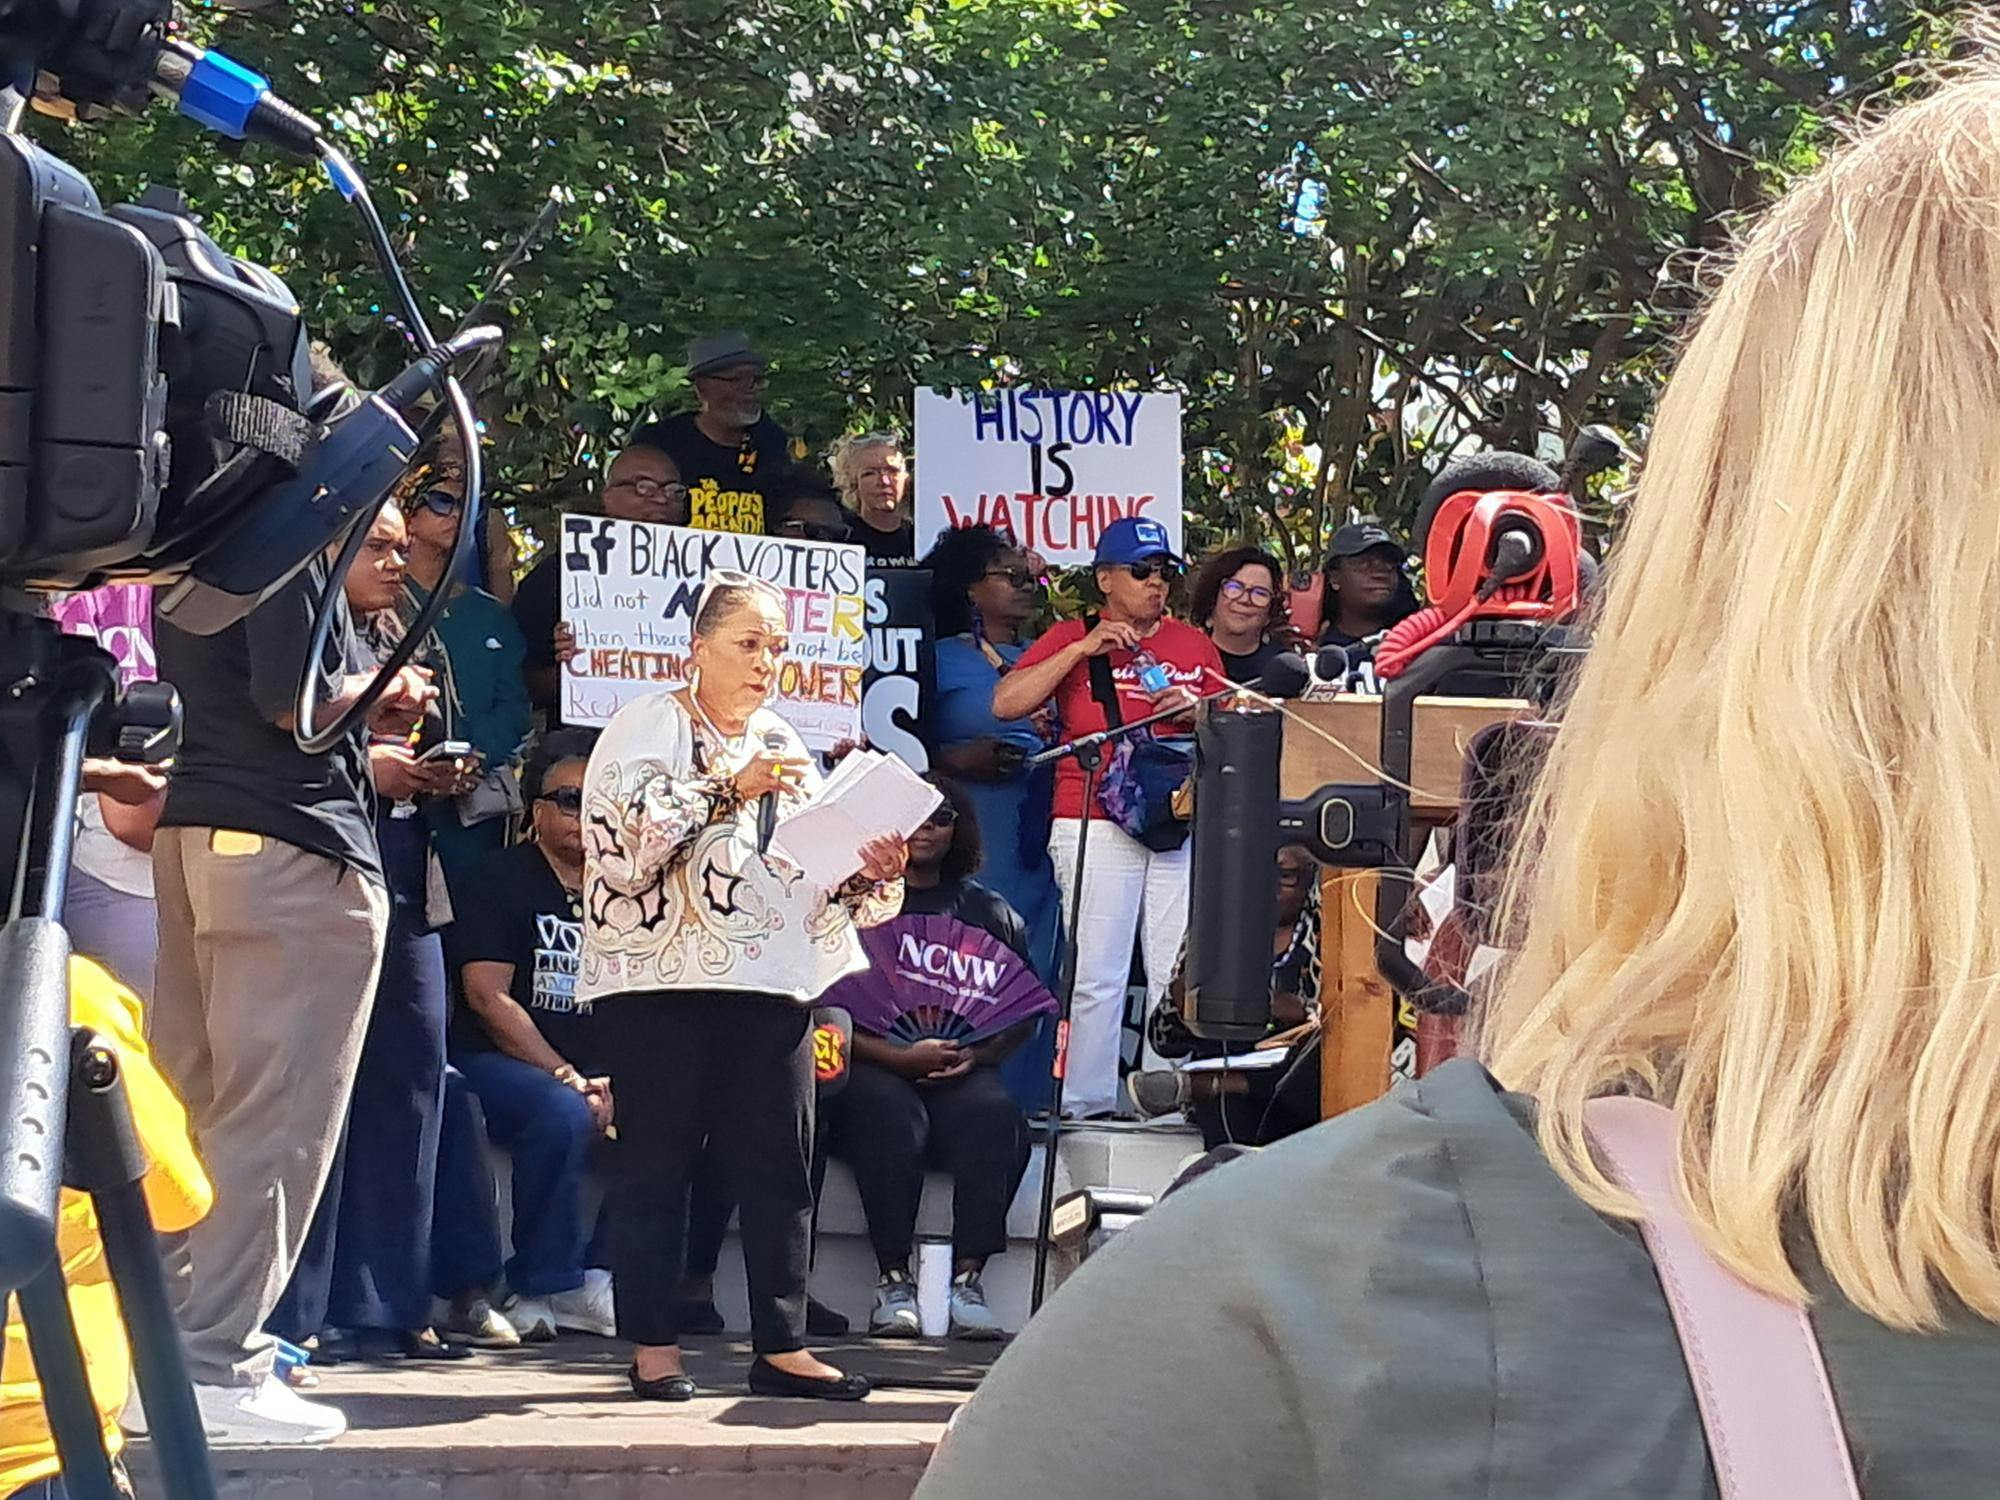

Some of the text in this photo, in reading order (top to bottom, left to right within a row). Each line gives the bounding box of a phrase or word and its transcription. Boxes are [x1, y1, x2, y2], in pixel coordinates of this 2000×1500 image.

[974, 388, 1142, 446] HISTORY
[1031, 442, 1074, 497] IS
[565, 518, 860, 596] If BLACK VOTERS
[566, 576, 604, 610] did
[613, 592, 649, 610] not
[795, 637, 828, 658] not
[837, 639, 863, 663] be
[778, 661, 863, 706] OVER
[898, 933, 1007, 990] NCNW
